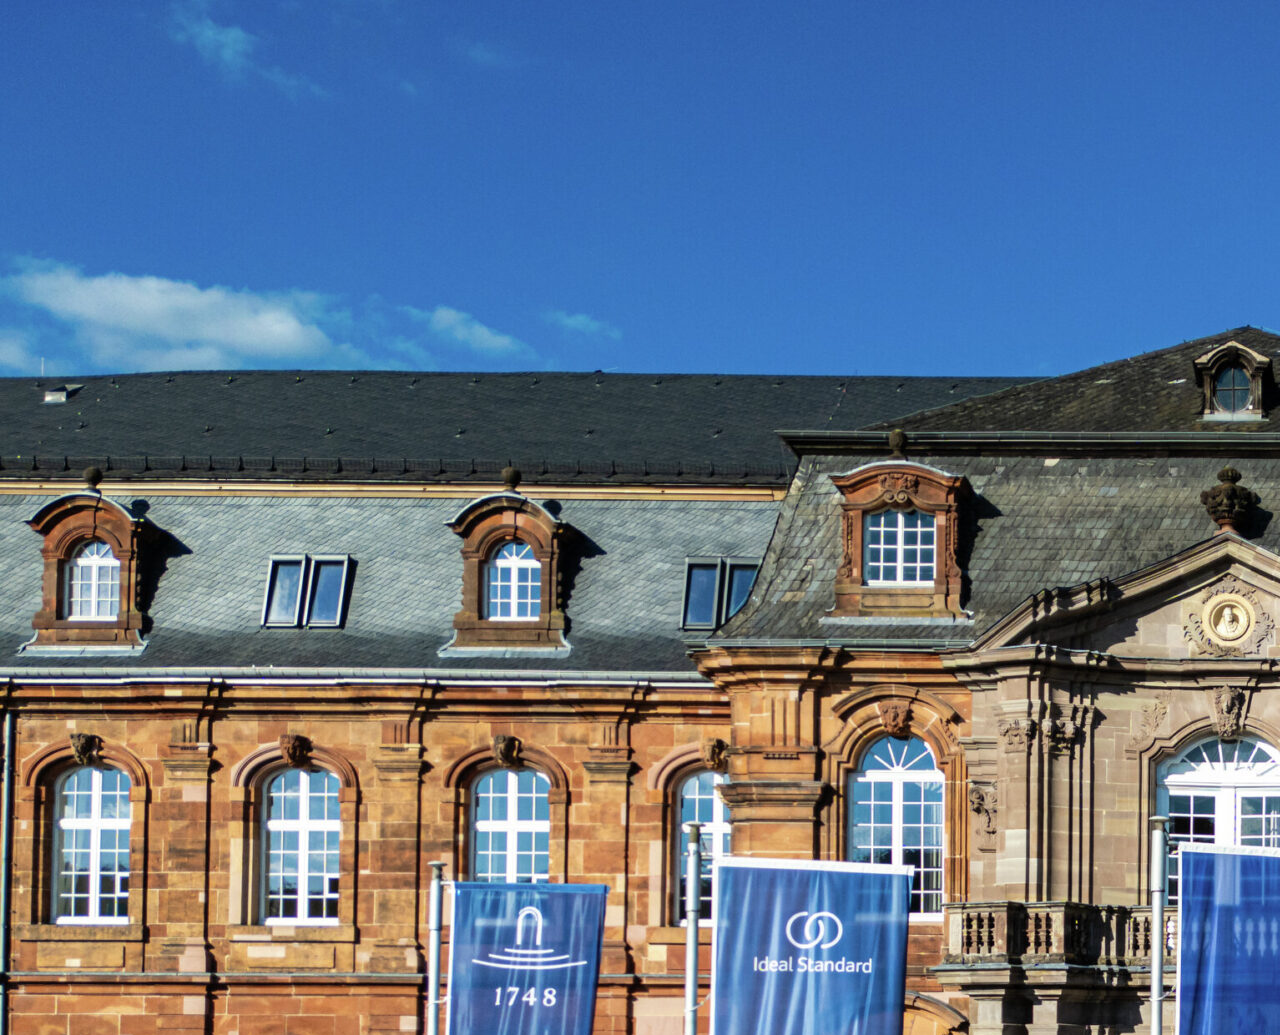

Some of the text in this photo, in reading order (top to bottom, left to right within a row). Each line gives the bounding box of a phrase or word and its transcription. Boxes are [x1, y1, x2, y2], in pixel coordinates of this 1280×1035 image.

[753, 955, 873, 975] Ideal Standard
[494, 985, 557, 1007] 1748
